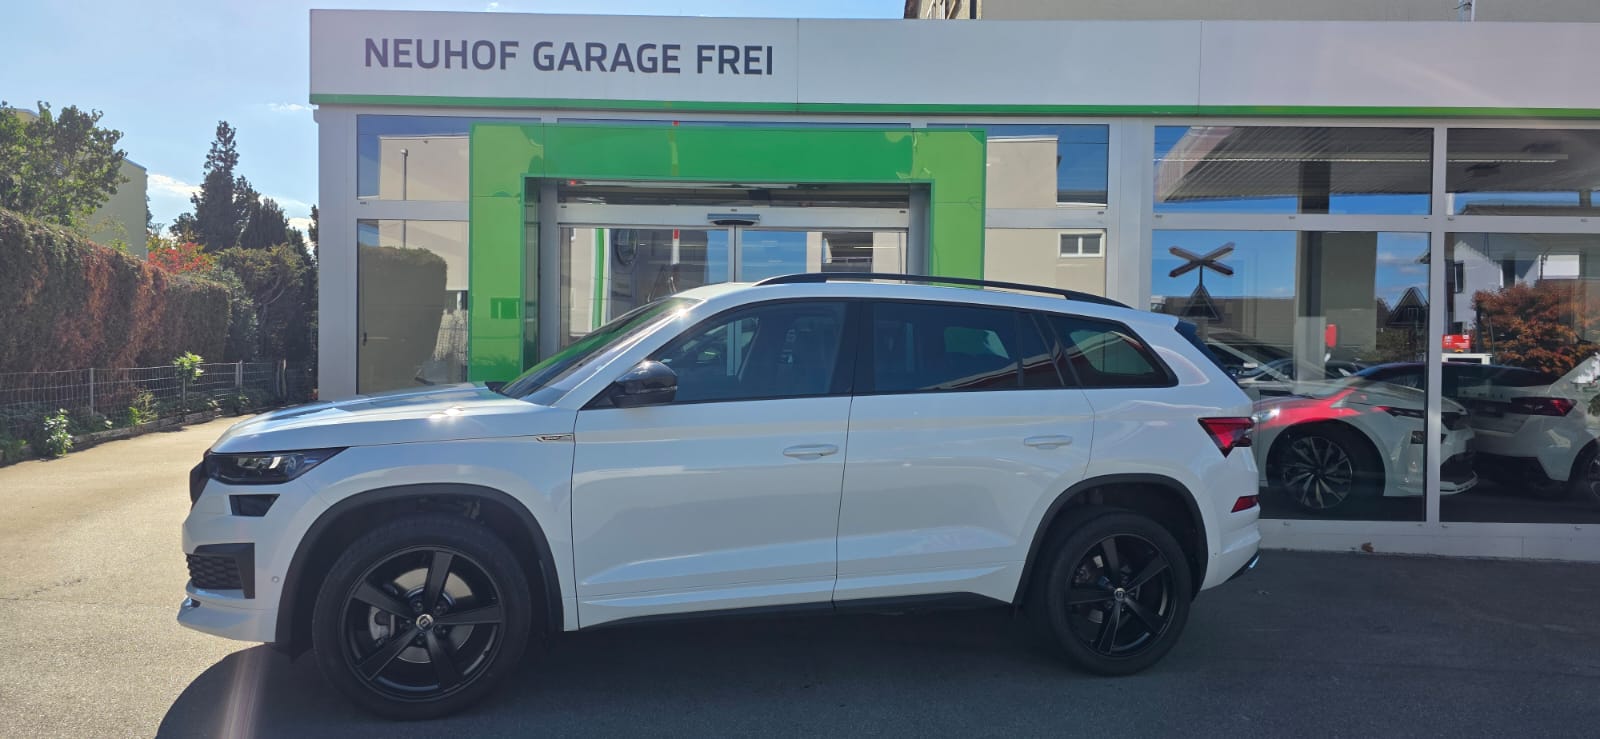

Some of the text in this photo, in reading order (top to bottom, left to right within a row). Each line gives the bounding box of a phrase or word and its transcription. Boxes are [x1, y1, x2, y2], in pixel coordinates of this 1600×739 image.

[365, 37, 773, 75] NEUHOF GARAGE FREI
